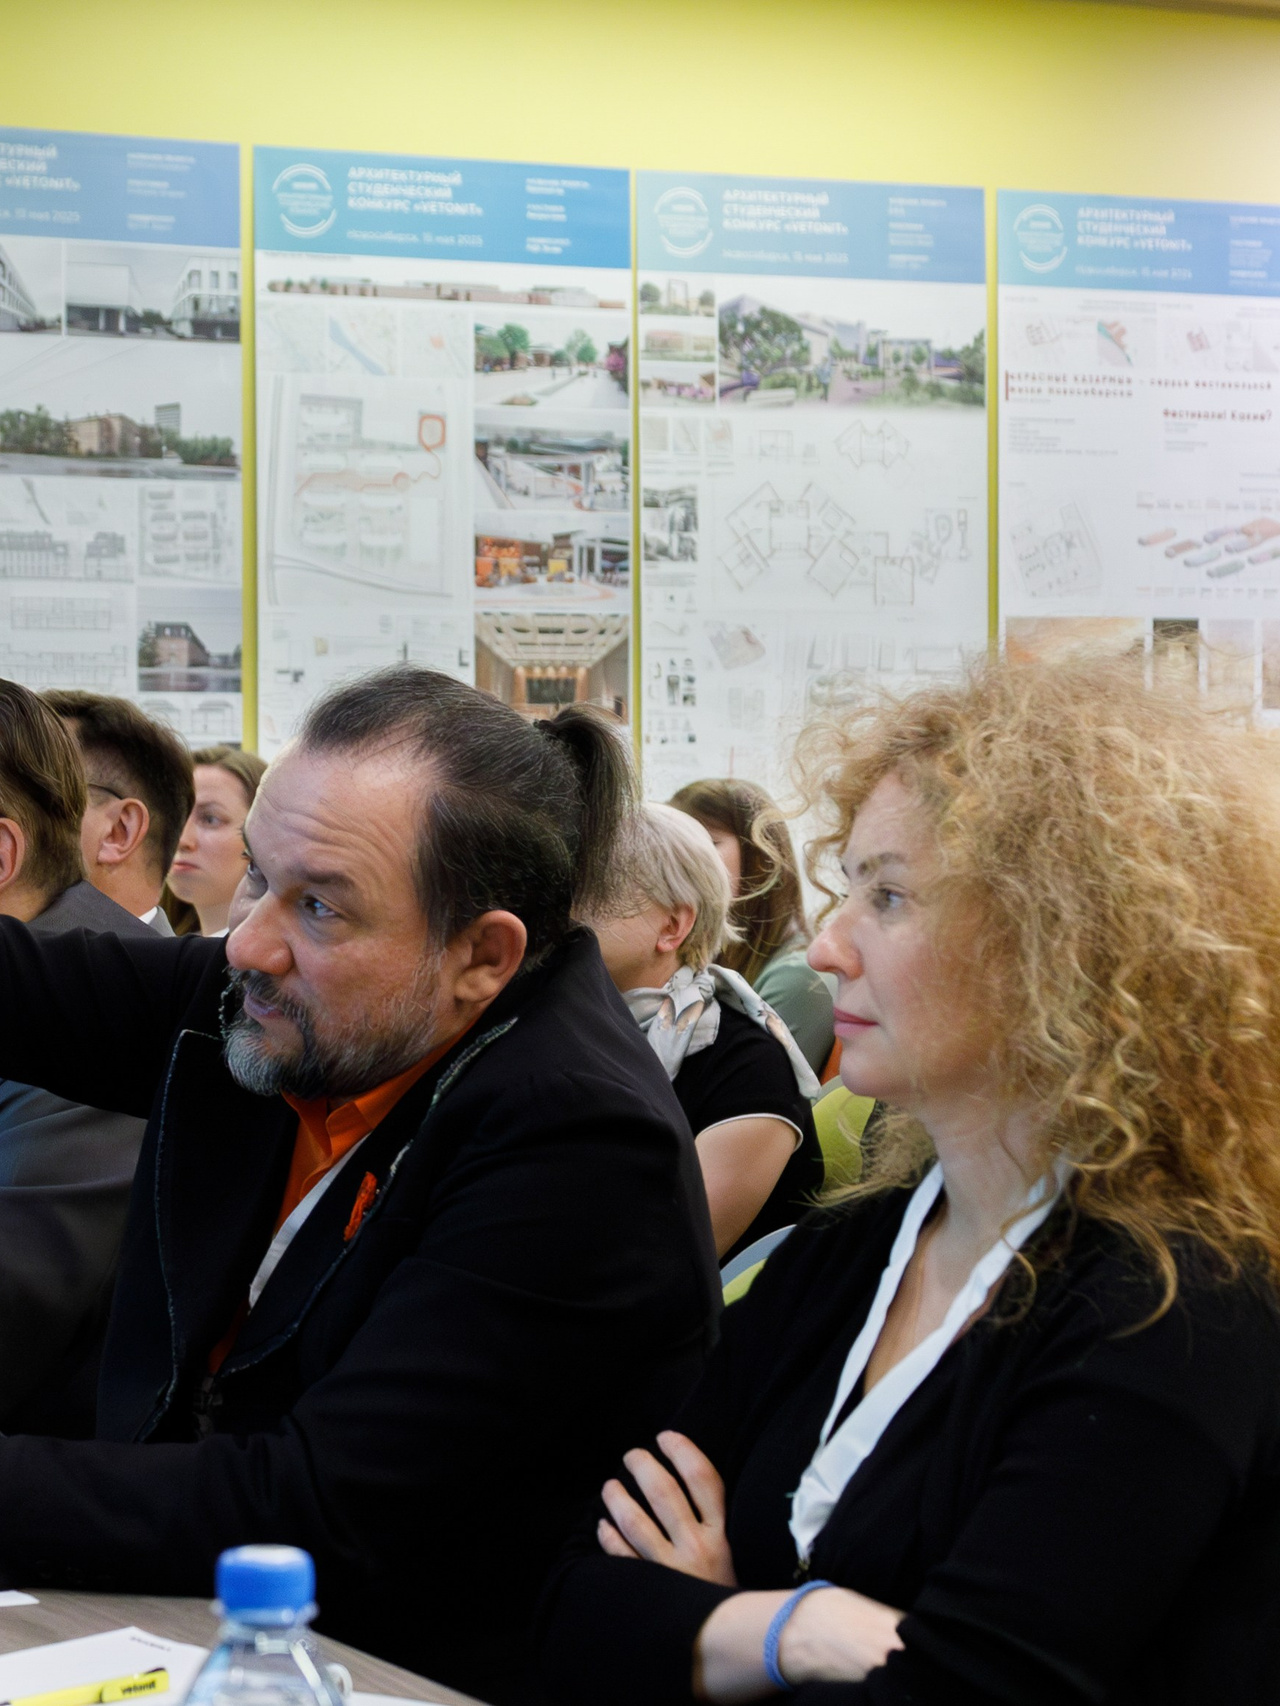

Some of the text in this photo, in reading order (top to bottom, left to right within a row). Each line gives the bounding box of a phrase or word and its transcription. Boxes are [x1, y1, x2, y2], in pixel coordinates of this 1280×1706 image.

[348, 166, 463, 187] АРХИТЕКТУРНЫЙ
[347, 182, 452, 199] СТУДЕНЧЕСКИЙ
[722, 189, 829, 206] АРХИТЕКТУРНЫЙ
[347, 197, 410, 214] КОНКУРС
[722, 204, 820, 219] СТУДЕНЧЕСКИЙ
[722, 218, 781, 233] КОНКУРС
